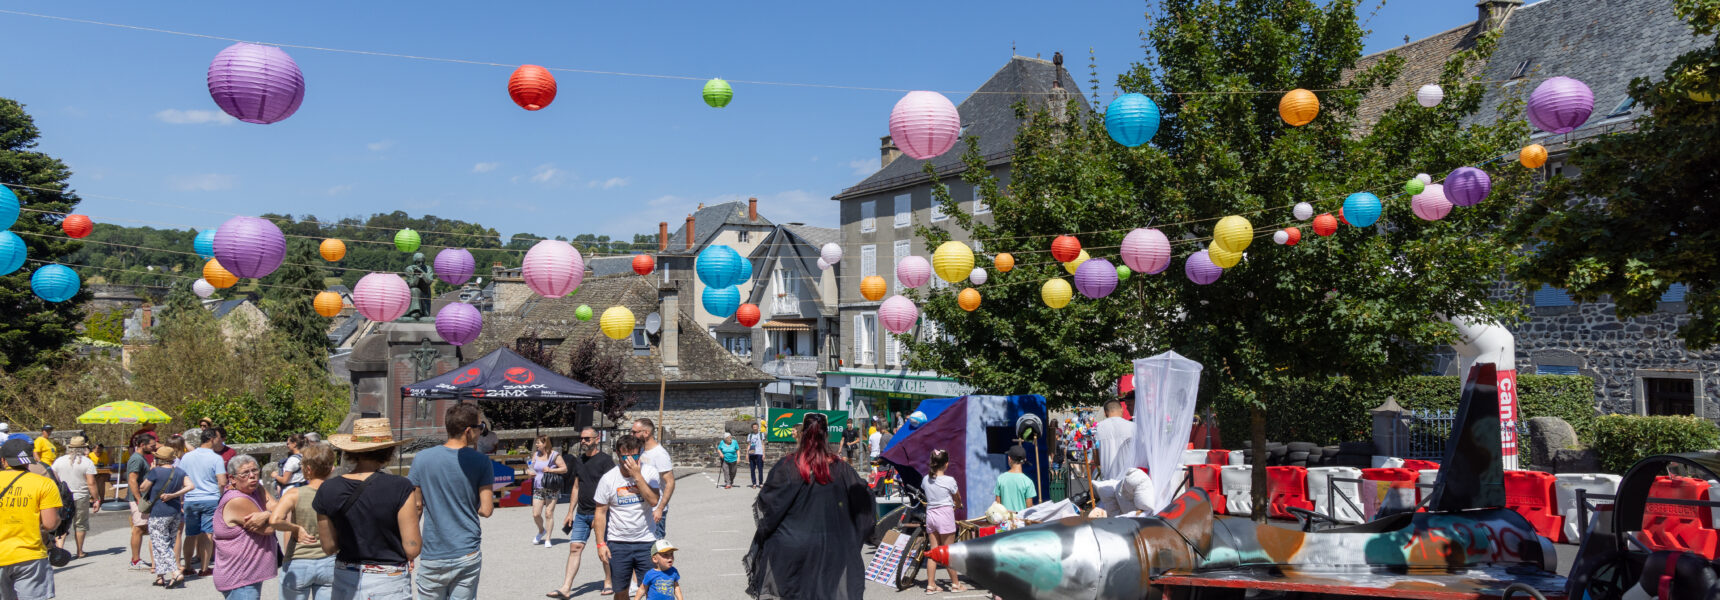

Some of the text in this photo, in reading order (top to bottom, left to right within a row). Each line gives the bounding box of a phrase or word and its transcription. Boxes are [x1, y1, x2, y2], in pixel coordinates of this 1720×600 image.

[855, 377, 927, 393] PHARMACIE
[486, 389, 528, 398] 24MX
[1500, 377, 1516, 449] cantal
